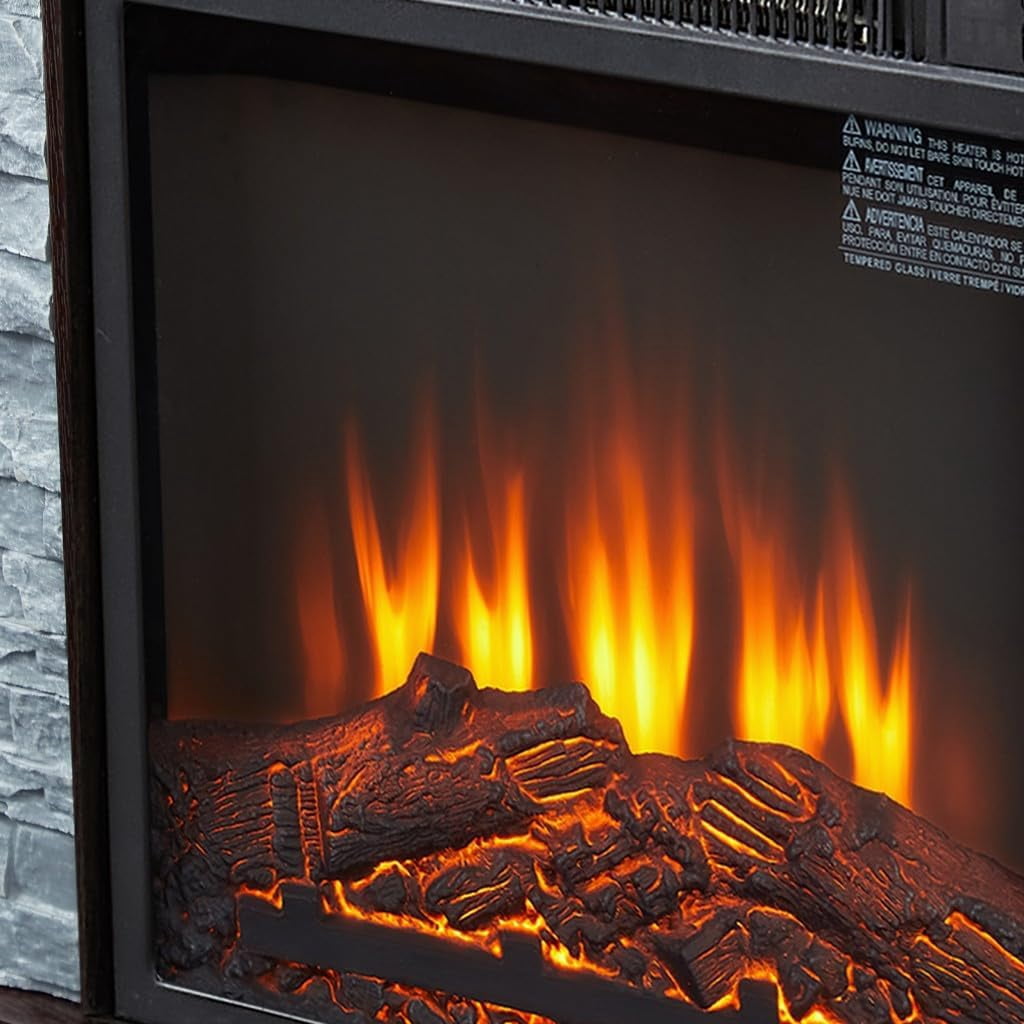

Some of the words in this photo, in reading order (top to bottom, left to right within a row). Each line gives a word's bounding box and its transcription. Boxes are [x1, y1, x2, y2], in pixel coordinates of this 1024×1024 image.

[864, 119, 922, 144] WARNING
[928, 138, 947, 150] THIS
[952, 142, 987, 157] HEATER
[992, 149, 1001, 160] IS
[1006, 152, 1024, 164] HOT
[875, 140, 888, 152] DO
[890, 143, 907, 155] NOT
[909, 146, 924, 159] LET
[926, 149, 950, 163] BARE
[952, 154, 972, 167] SKIN
[974, 158, 1004, 173] TOUCH
[1005, 164, 1024, 177] HOT
[842, 171, 881, 188] PENDANT
[884, 179, 904, 192] SON
[962, 194, 988, 208] POUR
[864, 157, 923, 182] AVERTISSEMENT
[926, 174, 944, 187] CET
[953, 179, 994, 196] APPAREIL
[1003, 188, 1016, 200] DE
[842, 184, 860, 196] NUE
[862, 187, 873, 199] NE
[874, 190, 895, 203] DOIT
[896, 194, 928, 209] JAMAIS
[929, 200, 970, 217] TOUCHER
[864, 207, 924, 232] ADVERTENCIA
[926, 225, 949, 238] ESTE
[951, 229, 1009, 249] CALENTADOR
[1010, 240, 1022, 252] SE
[868, 226, 891, 239] PARA
[896, 231, 926, 246] EVITAR
[1000, 251, 1014, 263] NO
[842, 233, 897, 253] PROTECCIÓN
[899, 244, 927, 259] ENTRE
[929, 250, 941, 261] EN
[943, 253, 989, 271] CONTACTO
[991, 262, 1011, 275] CON
[844, 252, 891, 270] TEMPERED
